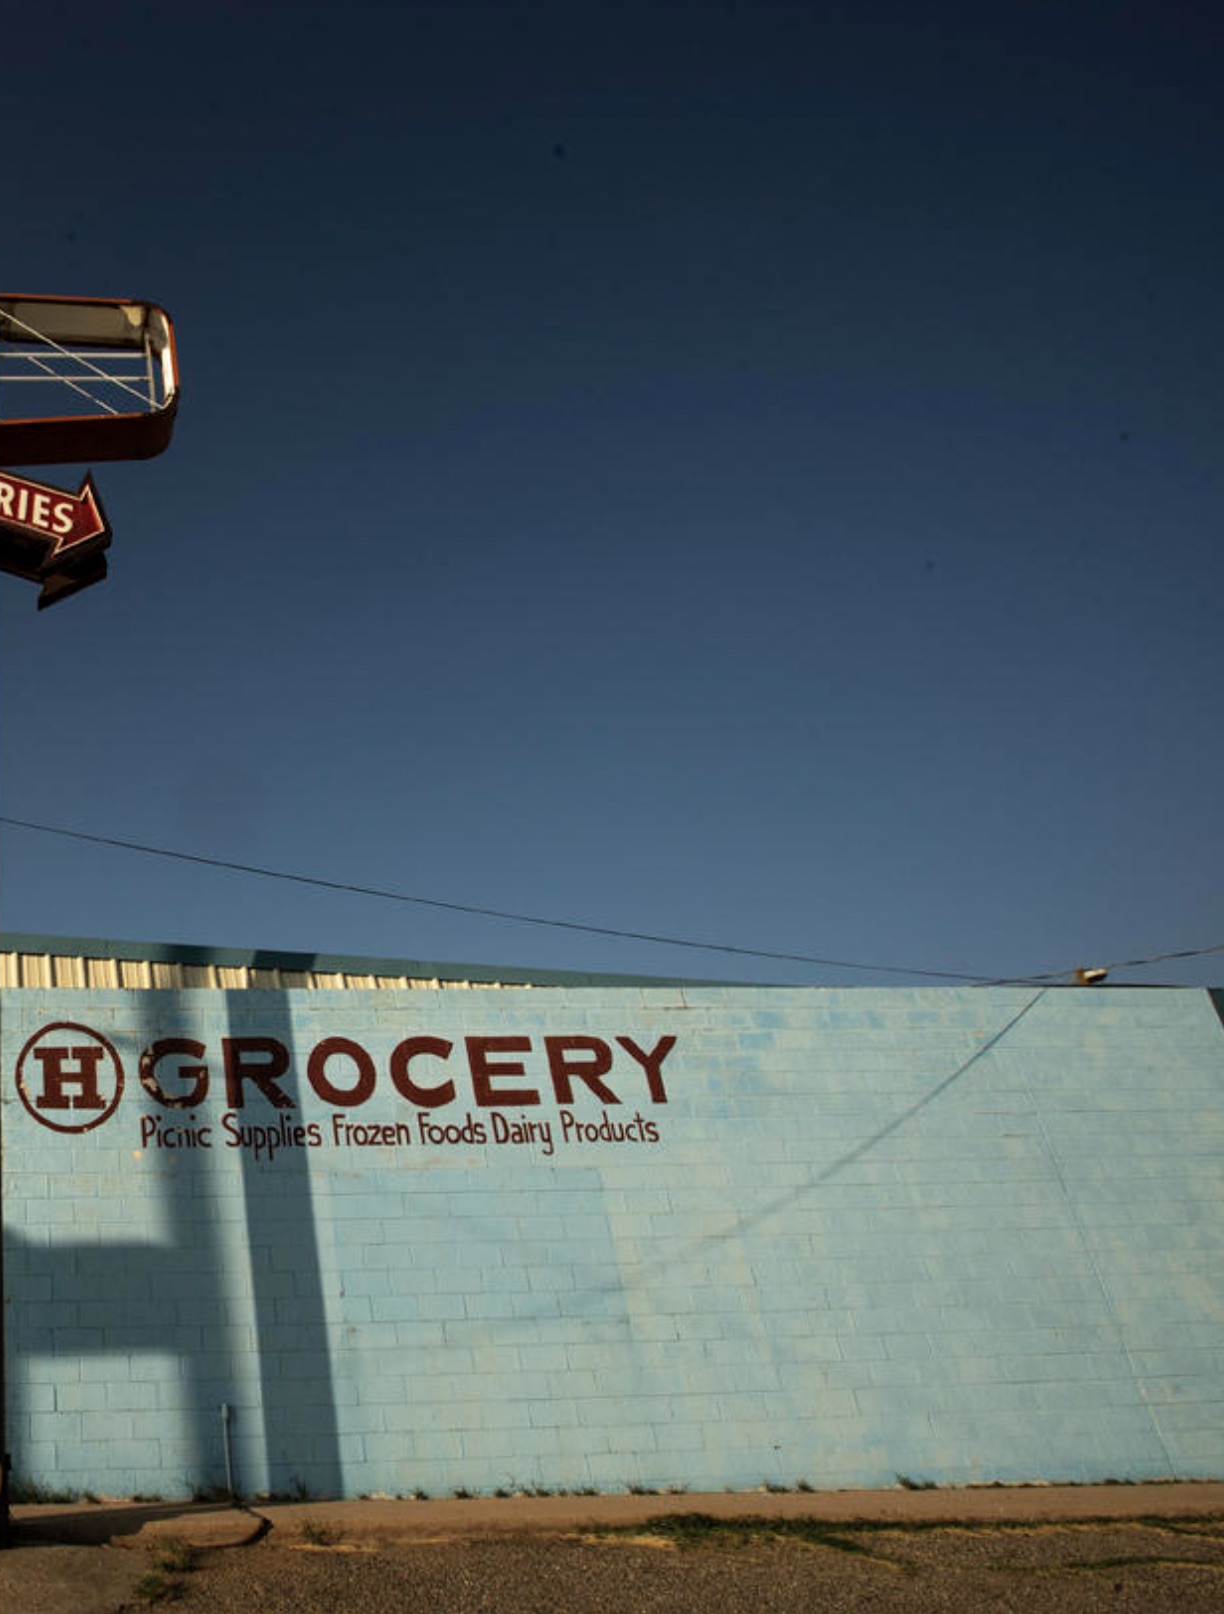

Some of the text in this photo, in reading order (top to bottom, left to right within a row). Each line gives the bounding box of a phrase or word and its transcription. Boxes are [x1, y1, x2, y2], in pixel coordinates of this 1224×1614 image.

[33, 1036, 677, 1109] H GROCERY
[221, 1112, 323, 1161] Supplies
[332, 1113, 411, 1147] Frozen
[417, 1111, 487, 1145] Foods
[490, 1111, 554, 1156] Dairy
[559, 1109, 661, 1144] Products
